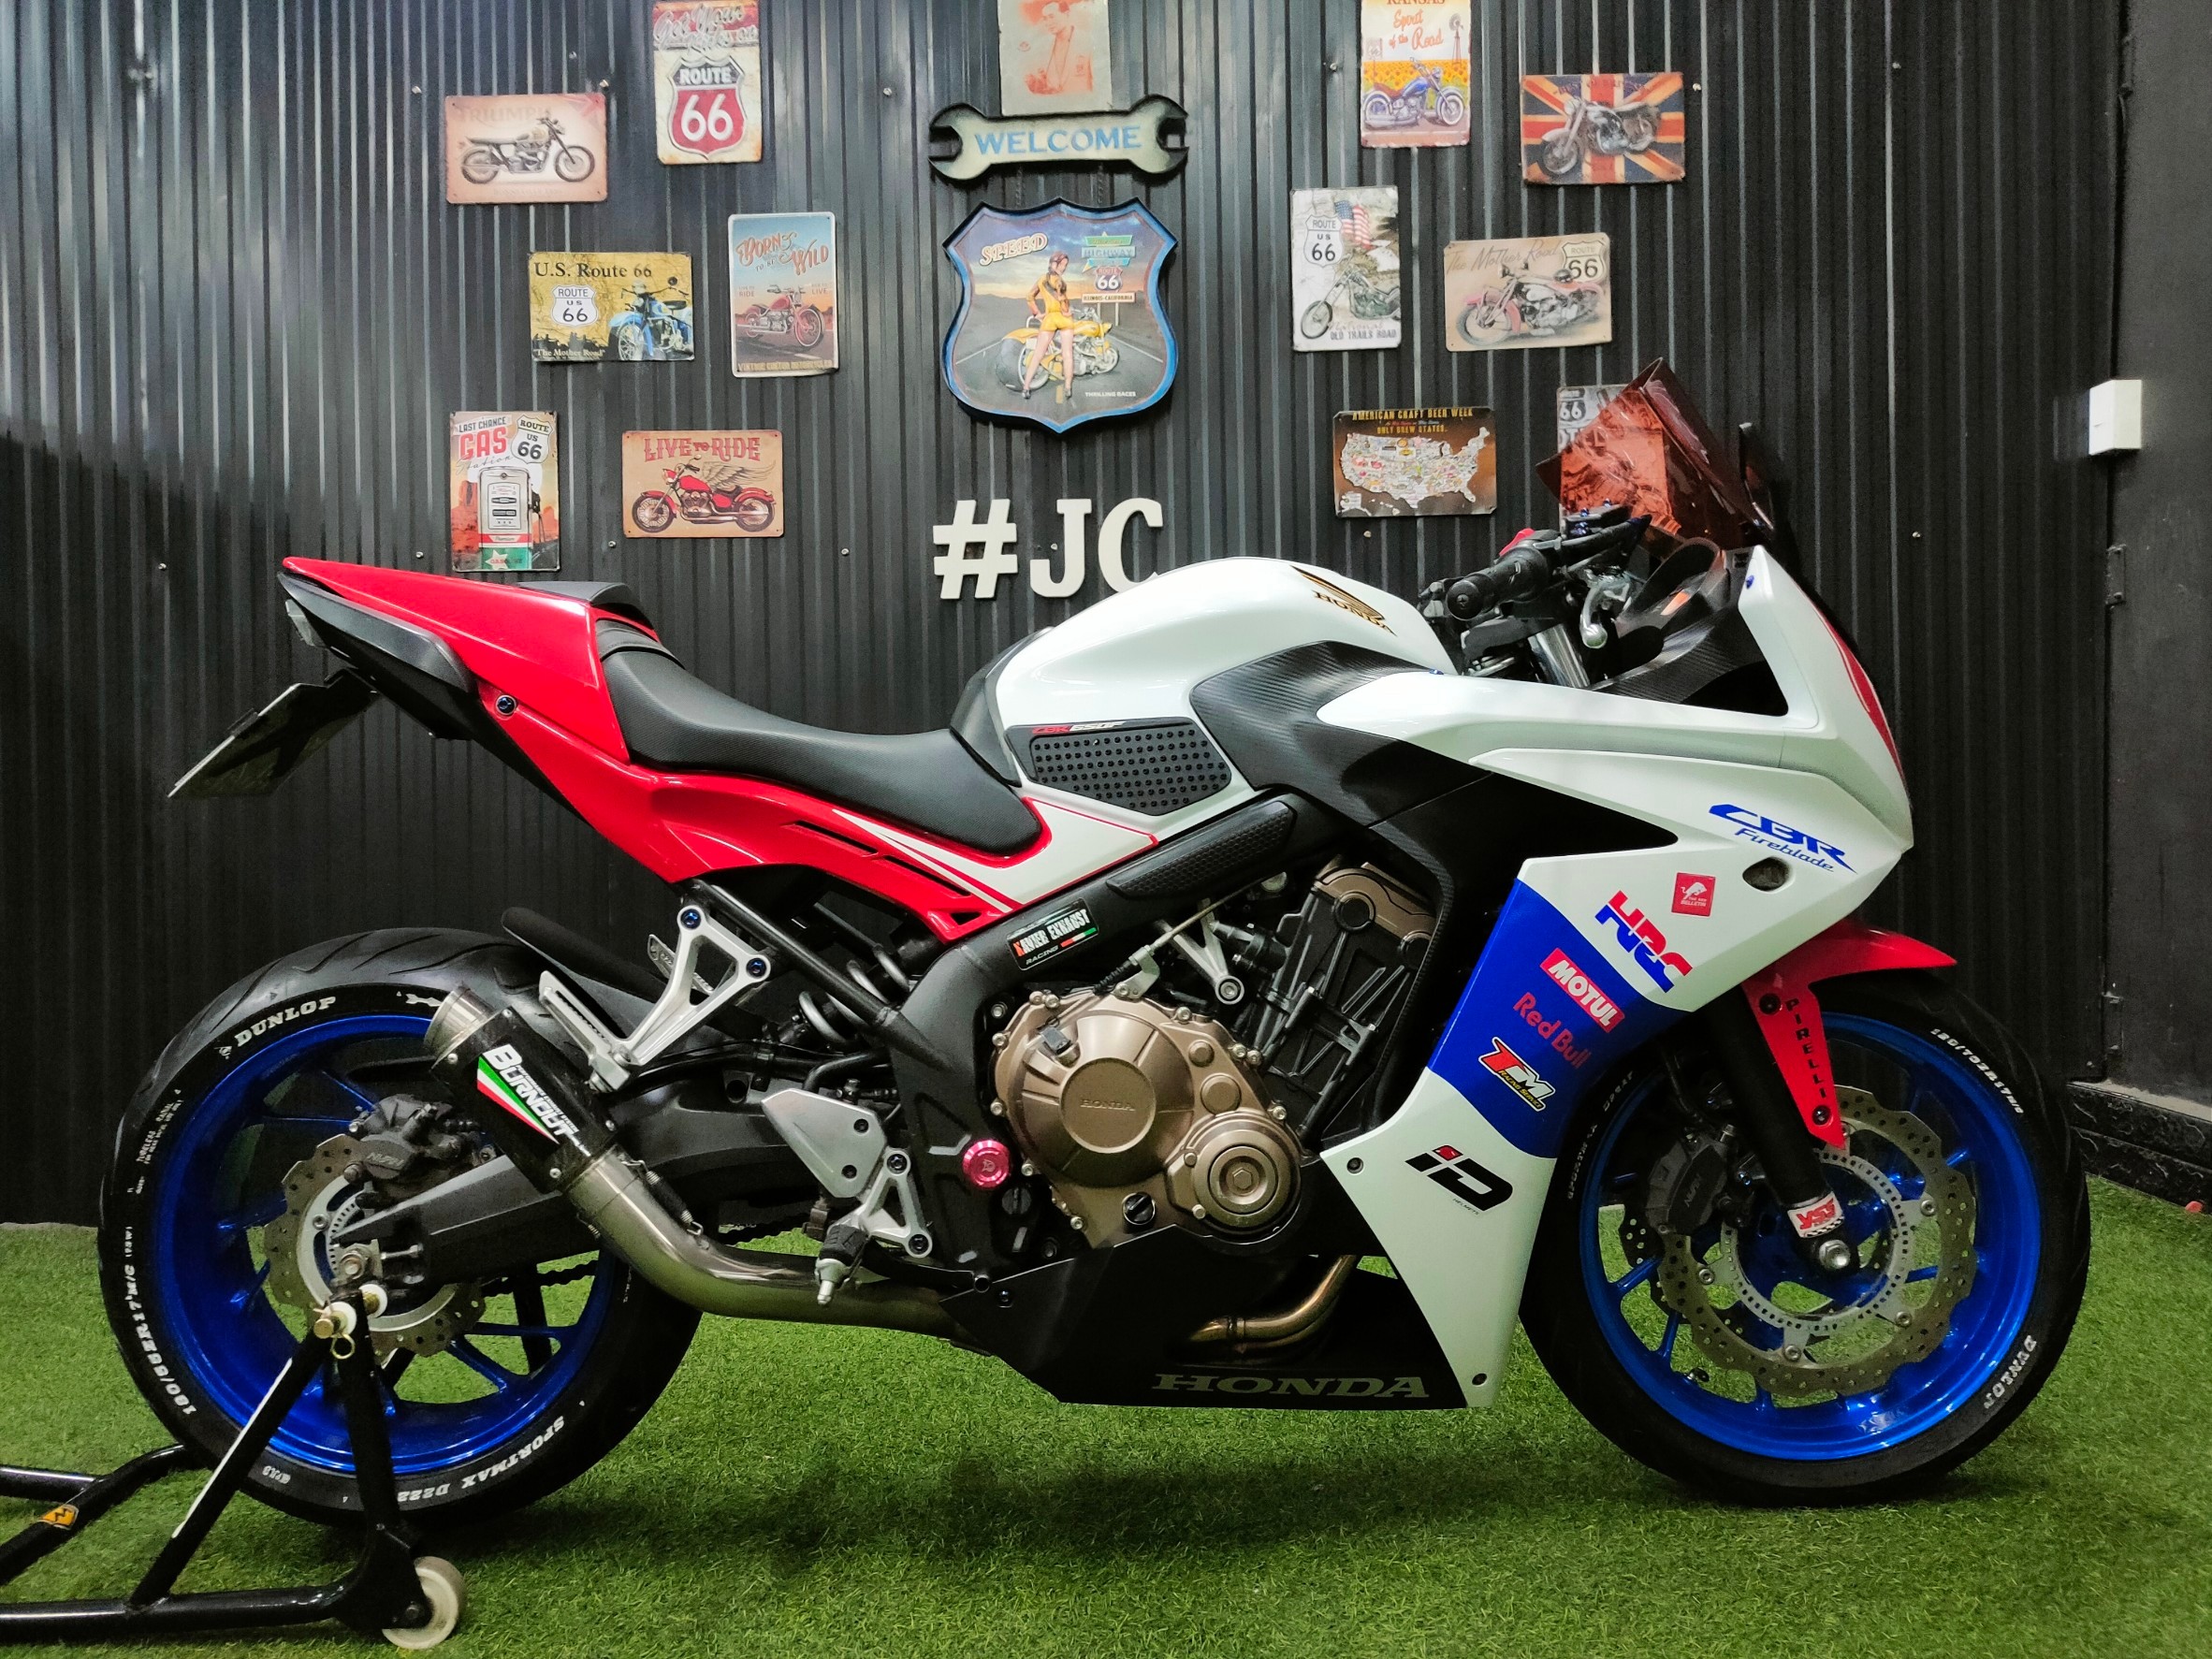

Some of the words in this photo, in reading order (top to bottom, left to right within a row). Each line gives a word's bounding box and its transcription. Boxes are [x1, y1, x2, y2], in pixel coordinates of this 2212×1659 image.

[1412, 26, 1444, 50] Road
[679, 66, 733, 85] ROUTE
[680, 94, 734, 142] 66
[974, 125, 1142, 155] WELCOME
[1313, 220, 1336, 228] ROUTE
[735, 232, 784, 267] BORN
[779, 239, 829, 275] WILD
[980, 232, 1048, 266] SPEED
[1085, 249, 1132, 257] HIGHWAY
[1312, 243, 1336, 261] 66
[1447, 250, 1467, 274] The
[1471, 245, 1522, 271] Mother
[1525, 239, 1562, 262] Road
[534, 262, 571, 277] U.S.
[577, 263, 628, 277] Route
[633, 263, 652, 278] 66
[1098, 275, 1119, 289] 66
[1567, 259, 1598, 280] 66
[558, 288, 589, 298] ROUTE
[562, 308, 589, 323] 66
[557, 349, 581, 357] Mother
[1352, 410, 1394, 420] AMERICAN
[1397, 409, 1424, 419] CRAFT
[1428, 408, 1448, 417] BEER
[1450, 407, 1474, 417] WEEK
[1560, 400, 1583, 420] 66
[459, 423, 476, 433] LAST
[478, 416, 507, 429] CHANCE
[520, 419, 550, 432] ROUTE
[1397, 426, 1416, 434] BREW
[459, 427, 507, 460] GAS
[517, 441, 543, 460] 66
[527, 434, 539, 443] US
[644, 437, 693, 462] LIVE
[692, 442, 710, 452] TO
[711, 437, 761, 462] RIDE
[932, 497, 1164, 599] #JC
[1312, 589, 1398, 637] HONDA
[1709, 804, 1858, 875] CBR
[1735, 827, 1834, 872] Fireblade
[1047, 909, 1090, 940] EXHAUST
[1594, 890, 1694, 994] HRC
[1026, 945, 1059, 966] RACING
[1548, 959, 1618, 1027] MOTUL
[234, 996, 337, 1048] DUNLOP
[1513, 992, 1562, 1040] Red
[1551, 1028, 1592, 1070] Bull
[1785, 997, 1826, 1099] PIRELLI
[1480, 1039, 1553, 1099] TM
[1079, 1099, 1137, 1112] HONDA
[1452, 1198, 1479, 1215] HELMETS
[1795, 1197, 1837, 1230] YSS
[1983, 1334, 2038, 1409] DUNLOP
[1152, 1374, 1430, 1399] HONDA
[460, 1415, 565, 1490] SPORTMAX
[397, 1483, 451, 1503] D222
